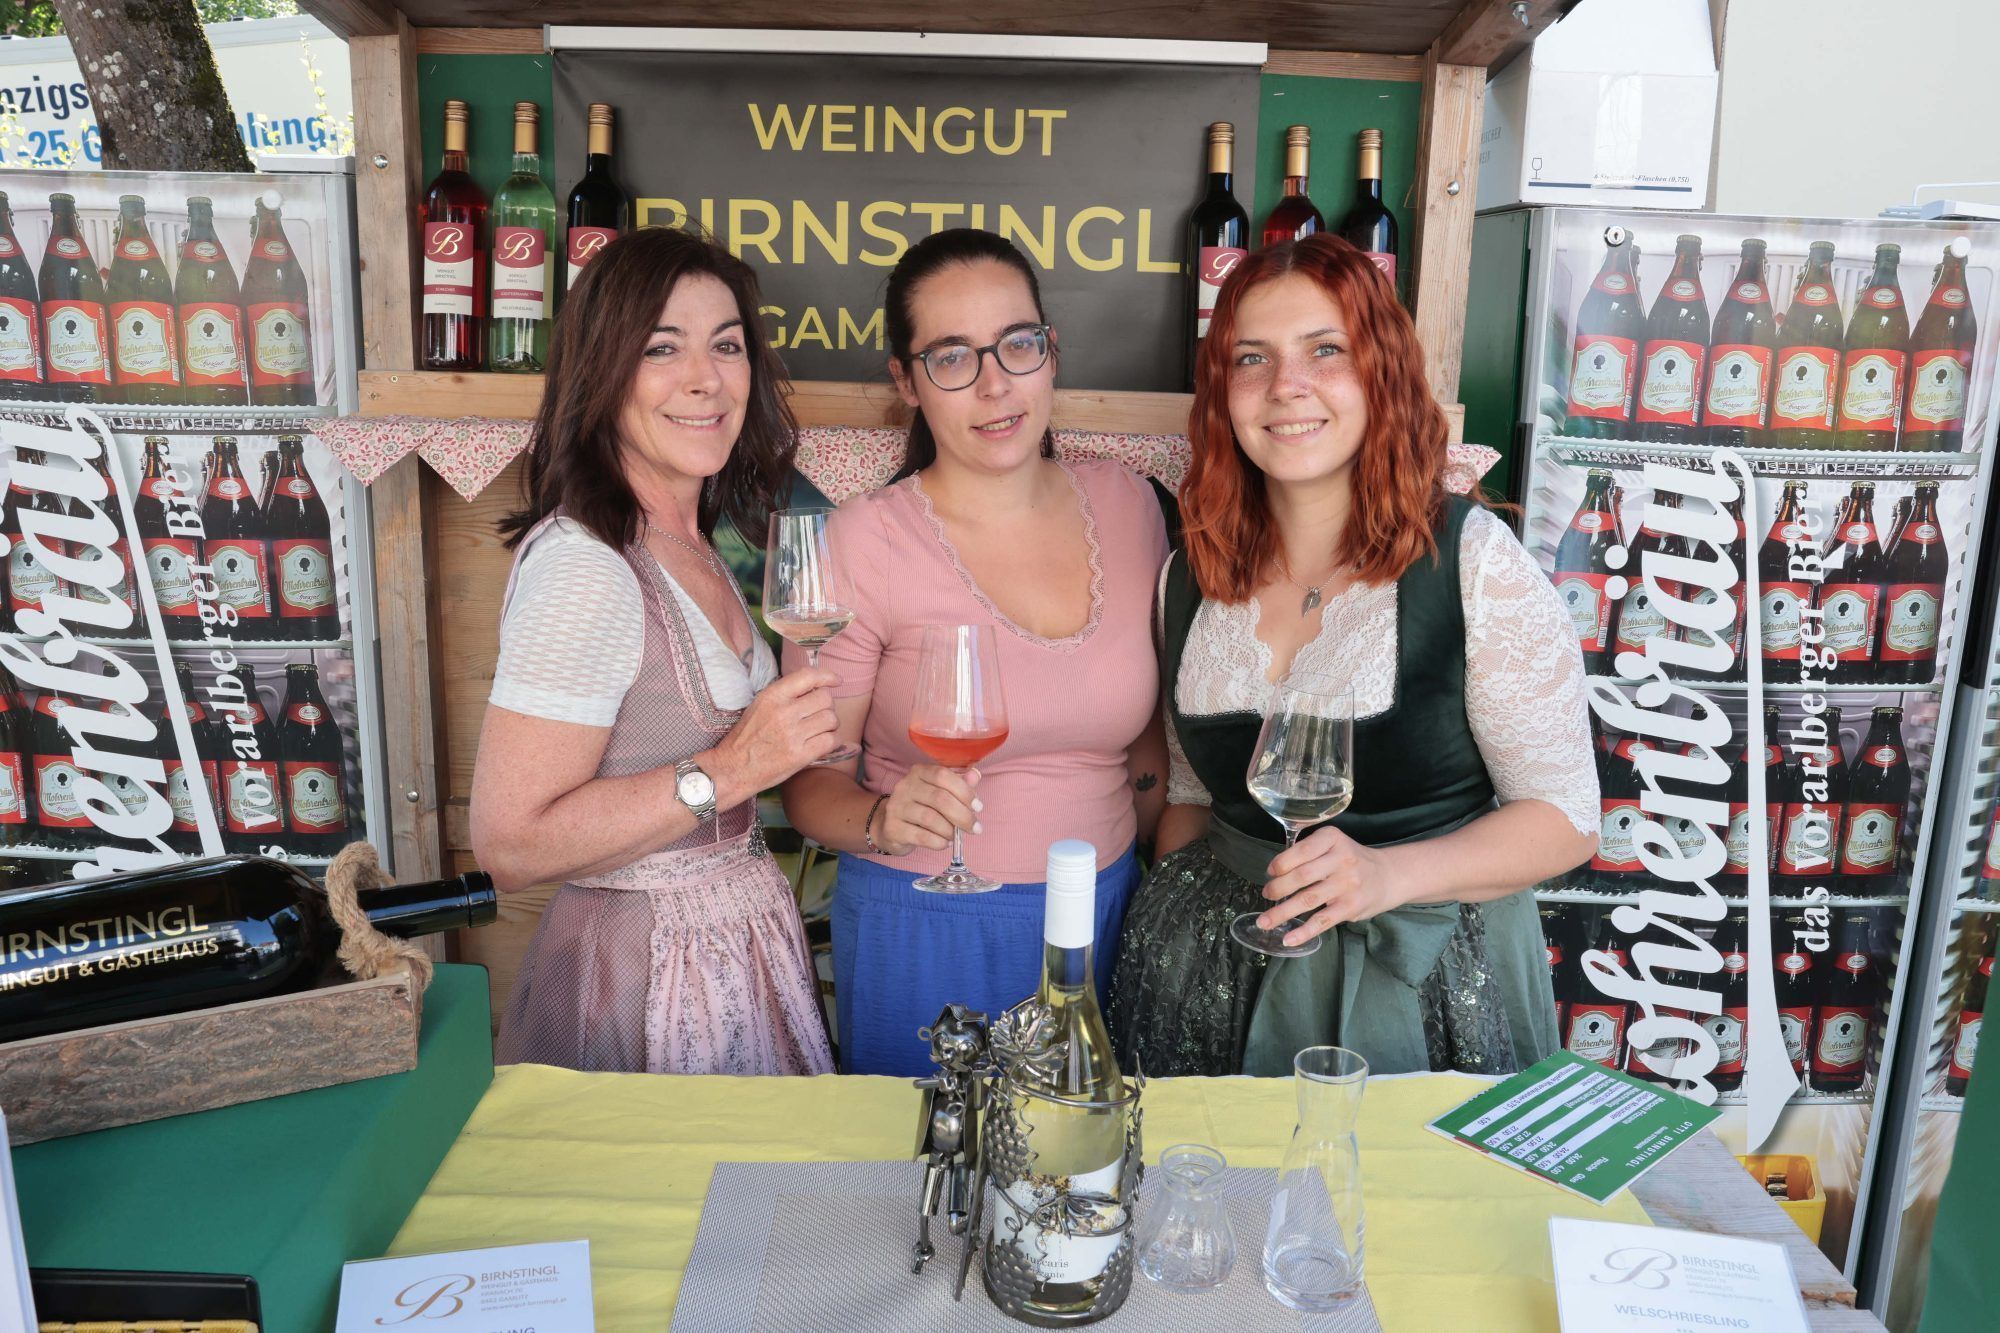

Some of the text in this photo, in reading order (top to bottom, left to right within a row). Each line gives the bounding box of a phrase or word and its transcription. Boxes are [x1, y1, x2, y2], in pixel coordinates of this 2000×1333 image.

[748, 103, 1067, 156] WEINGUT
[160, 446, 207, 540] Bier
[1787, 490, 1826, 585] Bier
[1790, 598, 1838, 871] Vorarlberger
[1793, 886, 1831, 953] das
[78, 959, 95, 977] &
[1671, 1120, 1694, 1134] OTTI
[1624, 1134, 1674, 1169] BIRNSTINGL
[1568, 1156, 1609, 1184] Flasche Glas
[481, 1265, 560, 1282] BIRNSTINGL
[1682, 1254, 1760, 1275] BIRNSTINGL
[374, 1273, 476, 1326] B
[1614, 1303, 1750, 1329] WELSCHRIESLING
